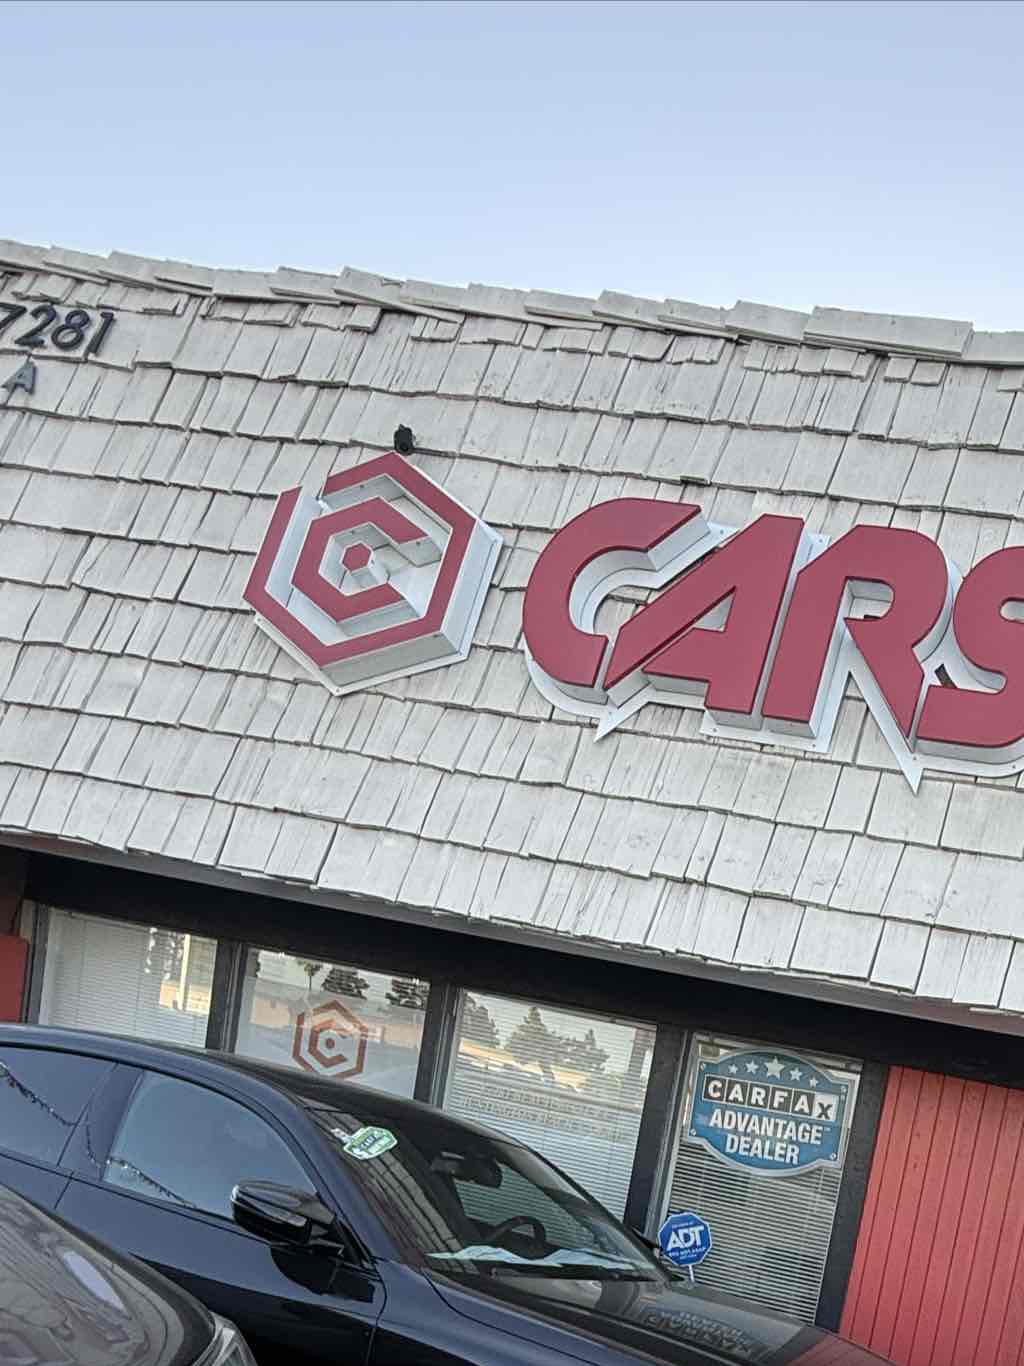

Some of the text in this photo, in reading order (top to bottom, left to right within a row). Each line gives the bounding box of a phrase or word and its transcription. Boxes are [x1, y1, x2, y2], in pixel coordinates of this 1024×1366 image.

[1, 361, 37, 395] A
[706, 1079, 834, 1121] CARFAX
[709, 1108, 825, 1145] ADVANTAGE
[725, 1133, 800, 1165] DEALER
[667, 1226, 705, 1251] ADT
